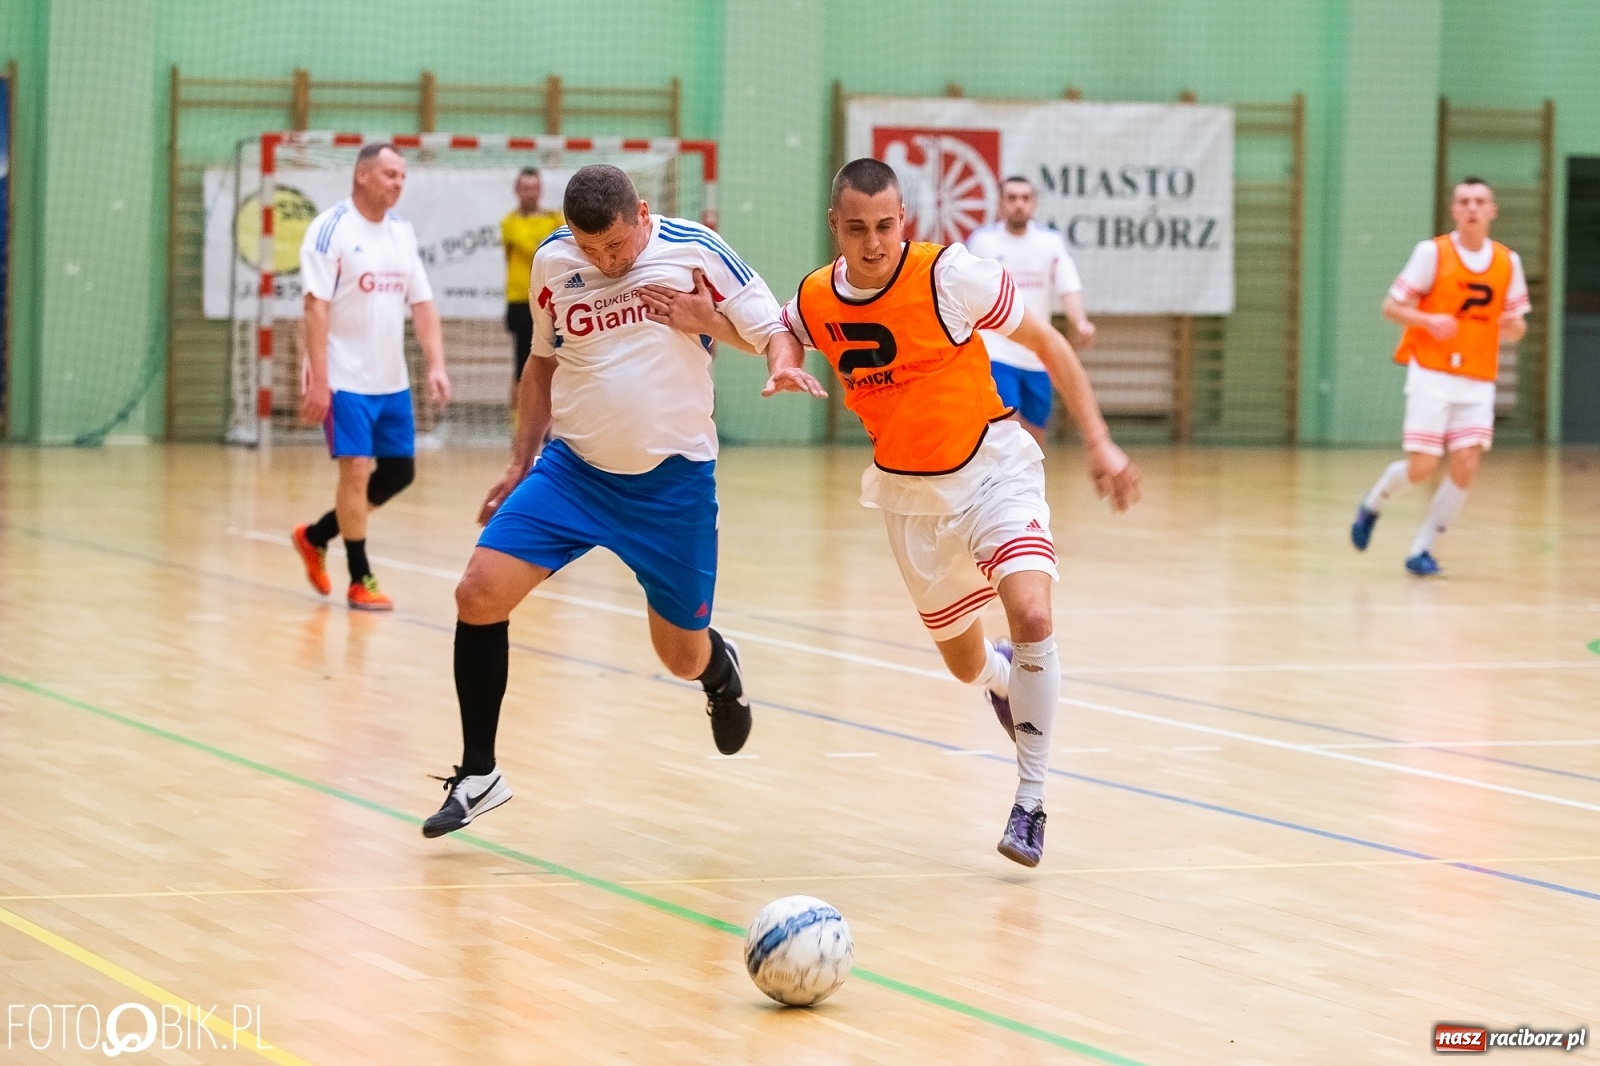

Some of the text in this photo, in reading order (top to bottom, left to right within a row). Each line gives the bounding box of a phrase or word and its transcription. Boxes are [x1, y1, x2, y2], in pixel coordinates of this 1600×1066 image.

[1040, 164, 1195, 199] MIASTO
[1046, 204, 1220, 250] CIBÓRZ
[594, 289, 641, 310] CUKIER
[566, 303, 651, 336] Giann
